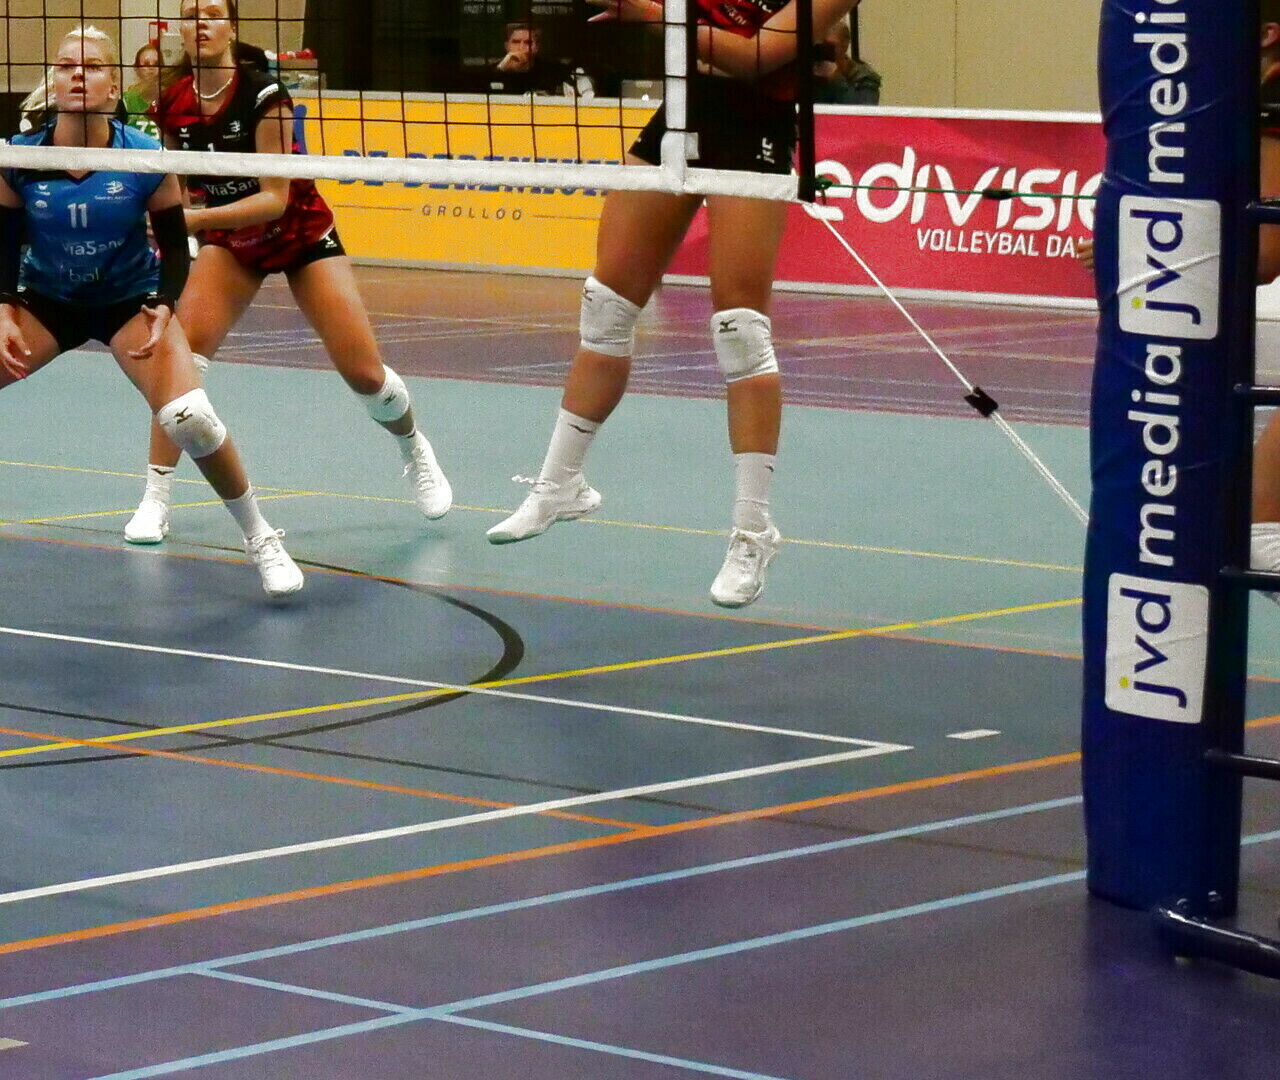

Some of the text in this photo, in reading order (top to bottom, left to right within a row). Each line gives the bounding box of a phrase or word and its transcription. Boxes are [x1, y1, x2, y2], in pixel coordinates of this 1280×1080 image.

[66, 202, 88, 229] 11
[421, 203, 523, 221] GROLLOO
[916, 228, 1040, 258] VOLLEYBAL
[1130, 209, 1201, 326] jvd
[1119, 344, 1188, 708] jvd media
